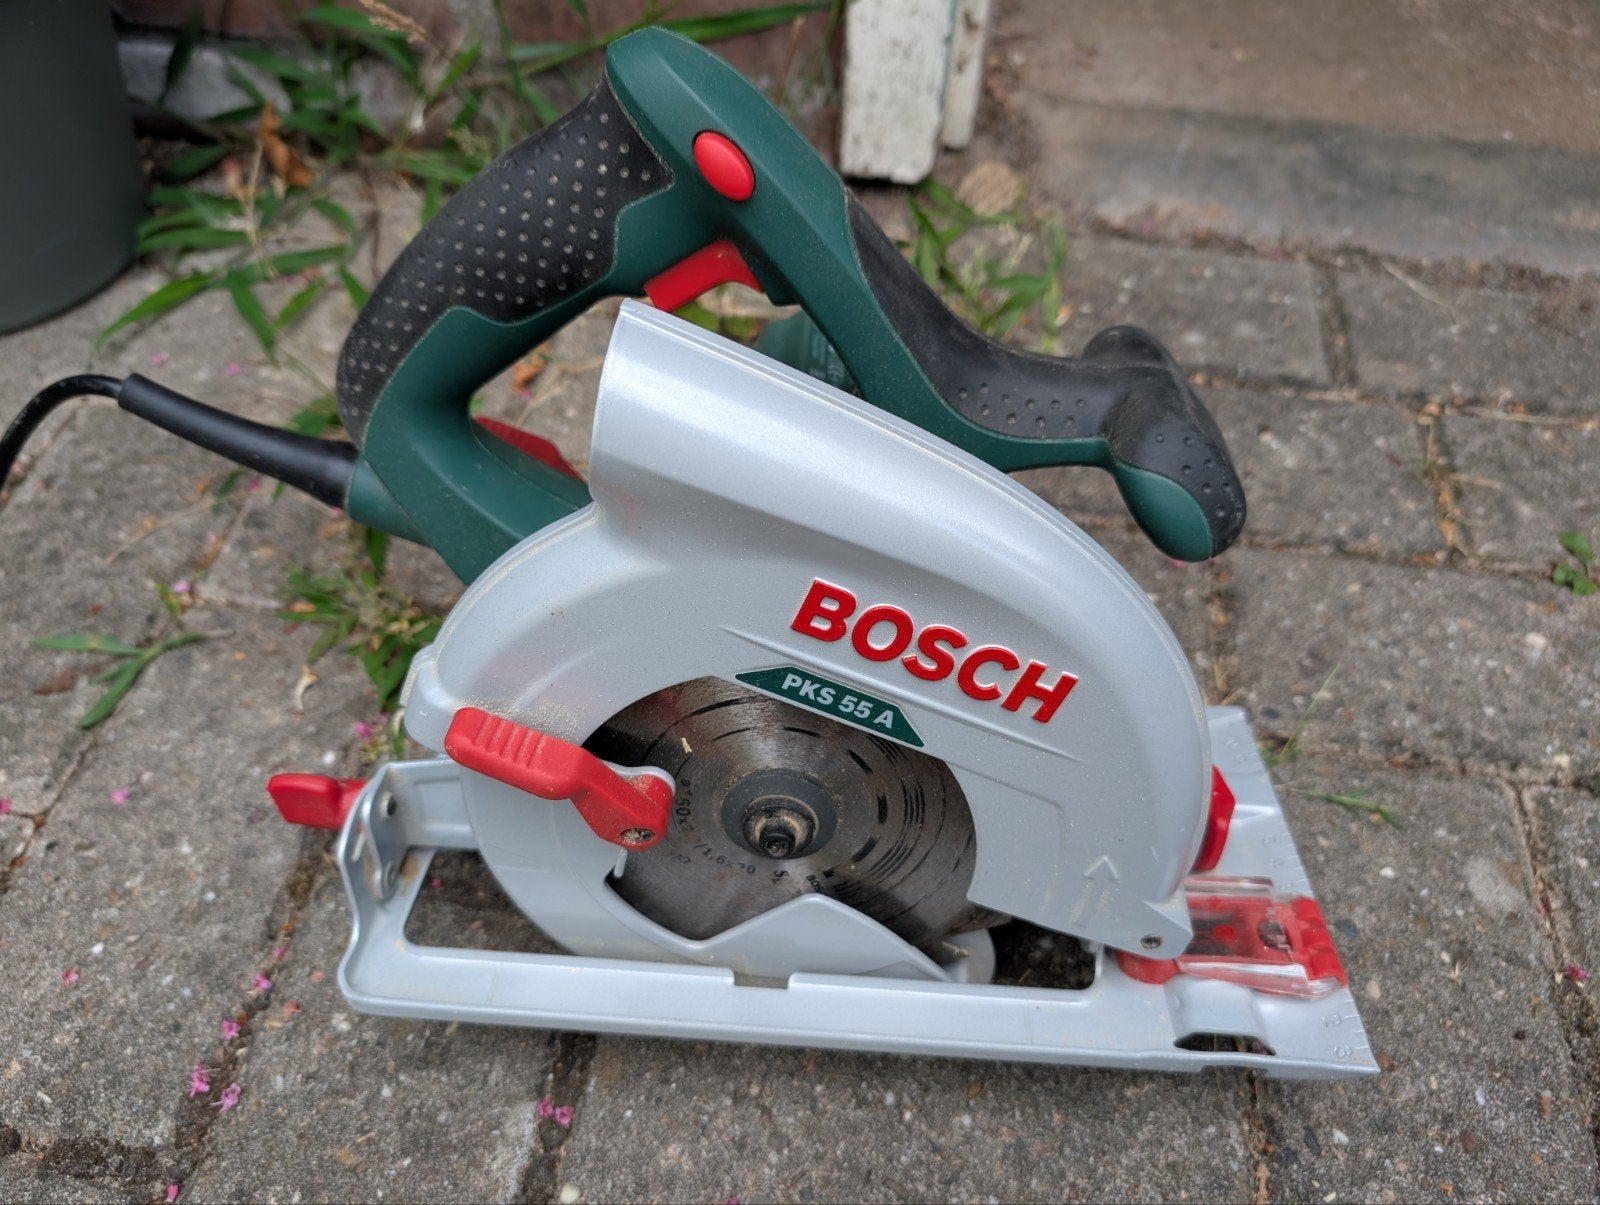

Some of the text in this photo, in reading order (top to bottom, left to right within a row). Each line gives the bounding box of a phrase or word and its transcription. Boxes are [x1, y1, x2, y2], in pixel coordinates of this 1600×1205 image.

[790, 577, 1079, 723] BOSCH
[781, 674, 895, 730] PKS 55 A
